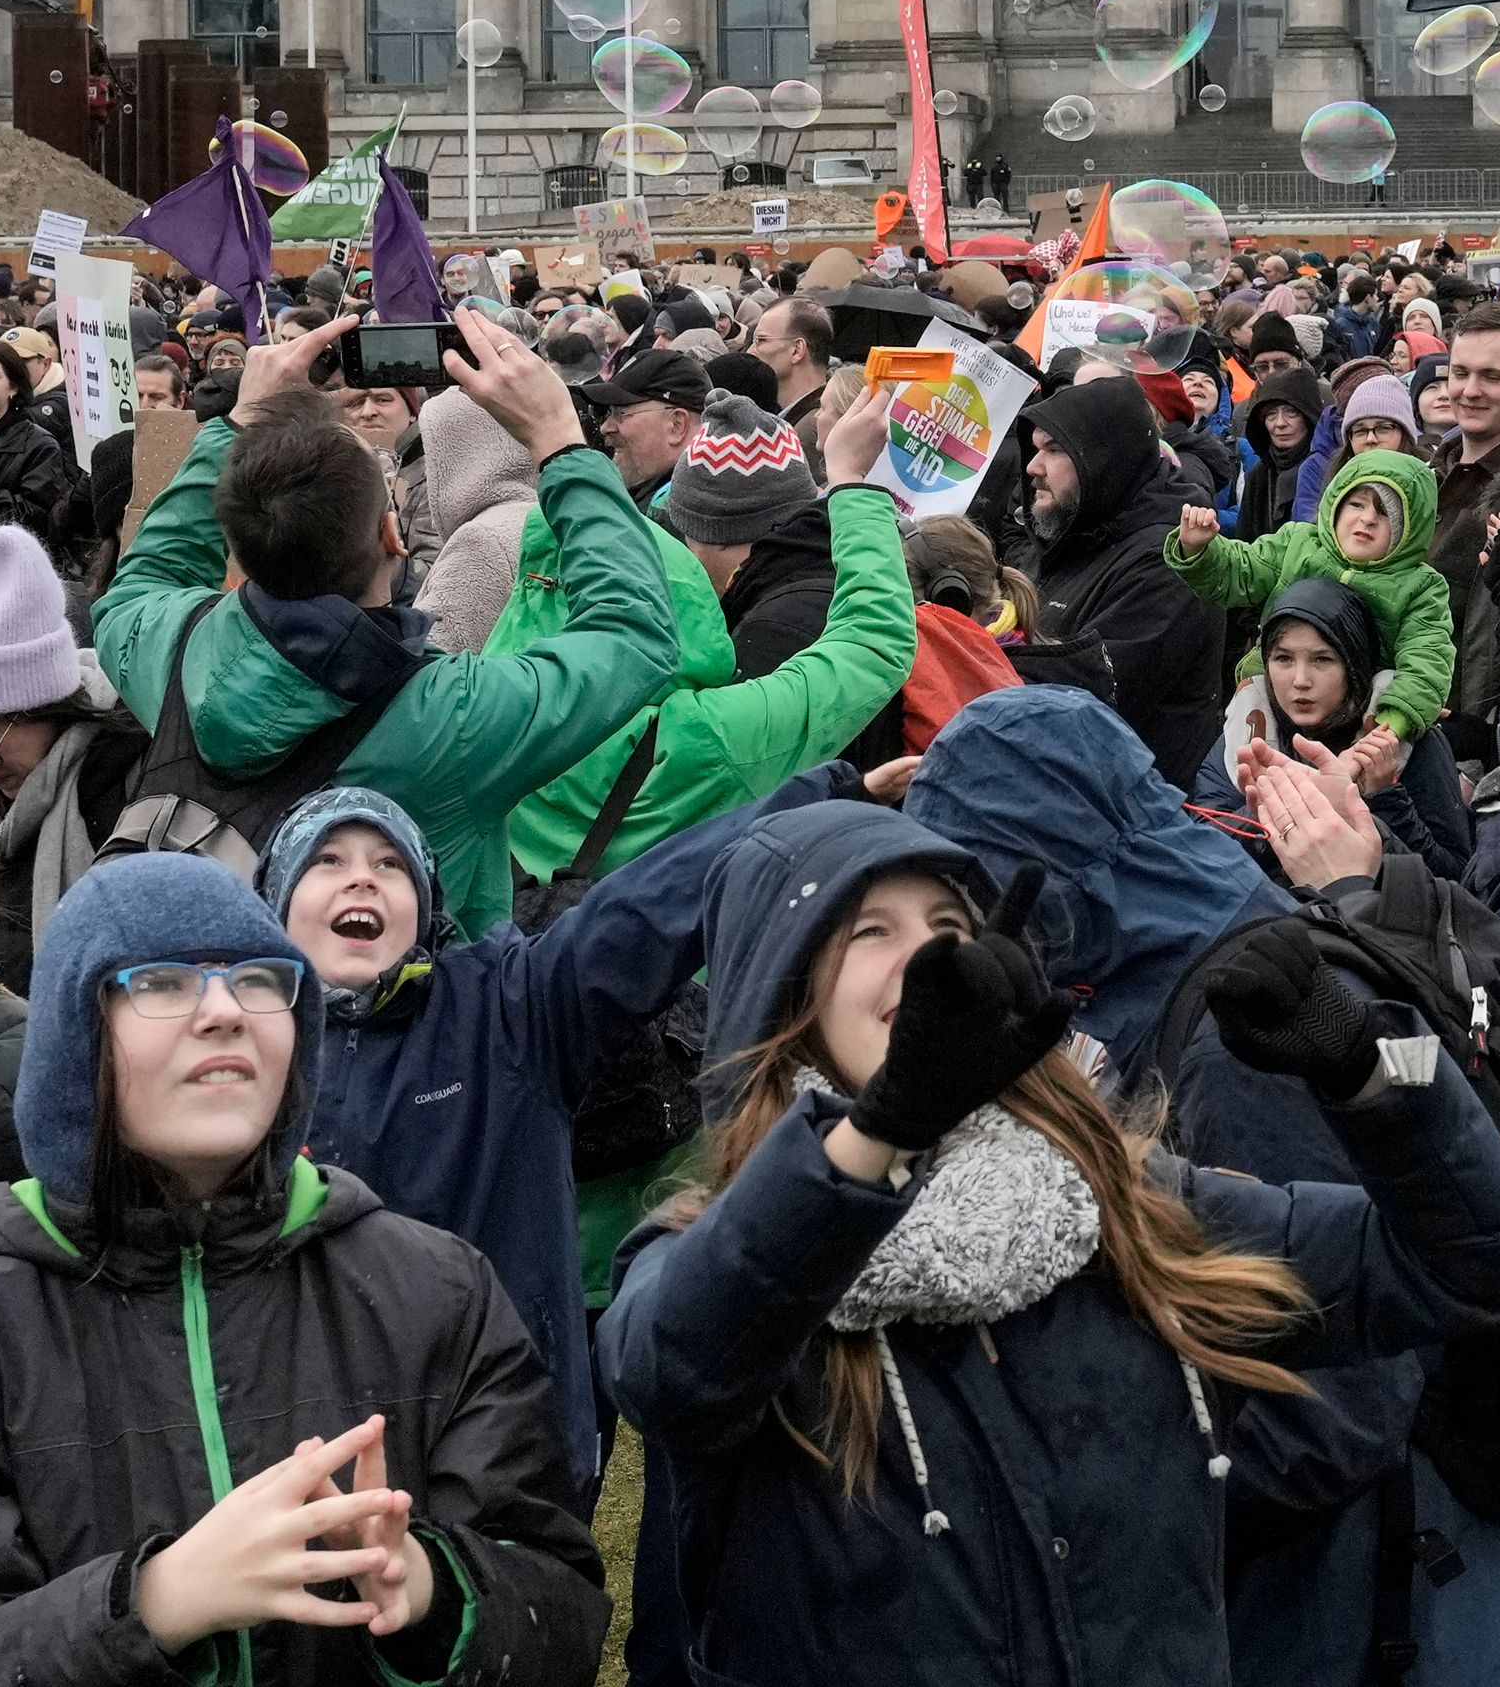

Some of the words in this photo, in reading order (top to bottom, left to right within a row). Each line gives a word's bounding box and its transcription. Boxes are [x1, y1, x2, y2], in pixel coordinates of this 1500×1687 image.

[755, 205, 785, 216] DIESMAL
[762, 216, 781, 227] NICHT
[950, 337, 970, 352] WER
[925, 395, 983, 446] STIMME
[902, 409, 948, 452] GEGEN
[904, 437, 920, 454] DIE
